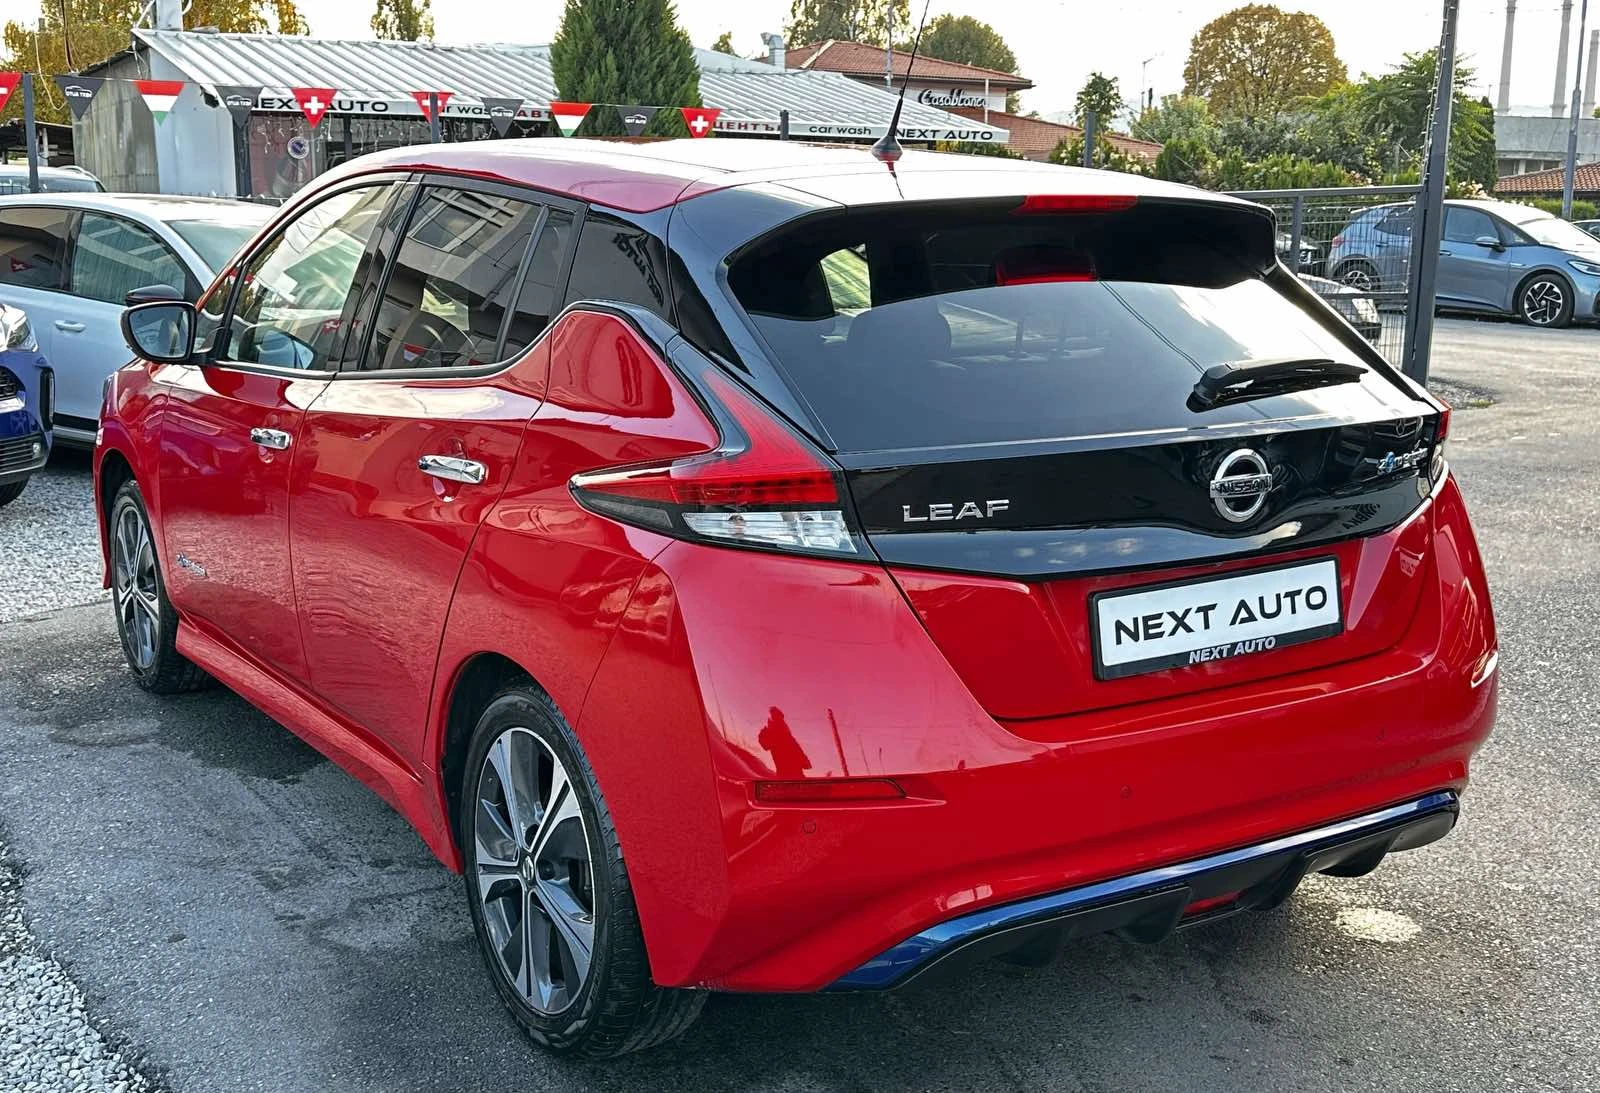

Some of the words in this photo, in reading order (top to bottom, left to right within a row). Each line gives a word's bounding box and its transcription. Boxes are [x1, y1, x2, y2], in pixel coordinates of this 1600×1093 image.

[713, 120, 781, 132] ЦЕНТЪ
[809, 125, 832, 134] car
[836, 126, 872, 136] wash
[895, 128, 940, 140] NEXT
[944, 130, 993, 141] AUTO
[902, 499, 1010, 522] LEAF
[1114, 603, 1218, 645] NEXT
[1229, 585, 1328, 626] AUTO
[1189, 644, 1231, 664] NEXT
[1234, 636, 1276, 656] AUTO
